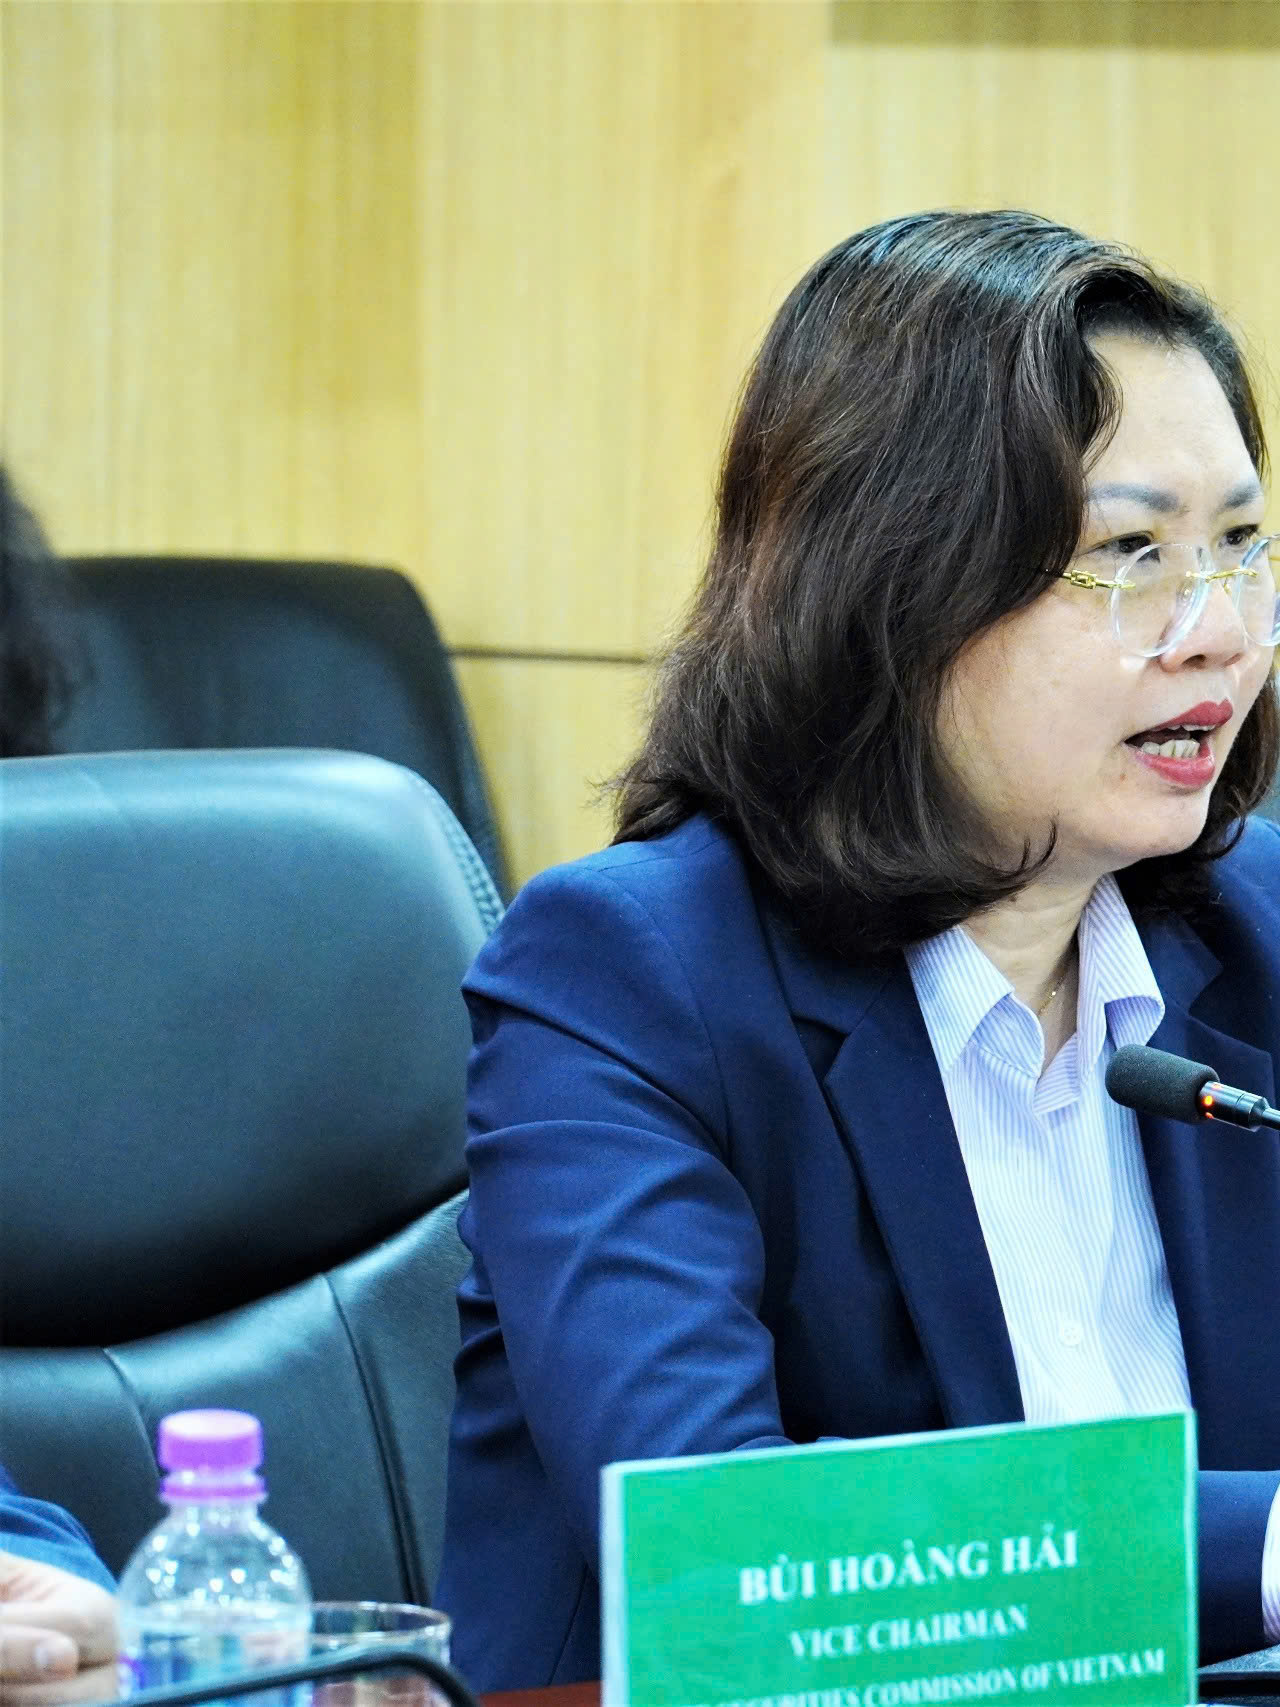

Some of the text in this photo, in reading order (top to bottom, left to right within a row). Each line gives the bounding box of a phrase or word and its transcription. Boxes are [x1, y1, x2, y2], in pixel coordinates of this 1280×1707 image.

[789, 1604, 1027, 1660] VICE CHAIRMAN
[863, 1666, 1017, 1707] COMMISSION
[1020, 1661, 1050, 1692] OF
[1056, 1648, 1166, 1685] VIETNAM
